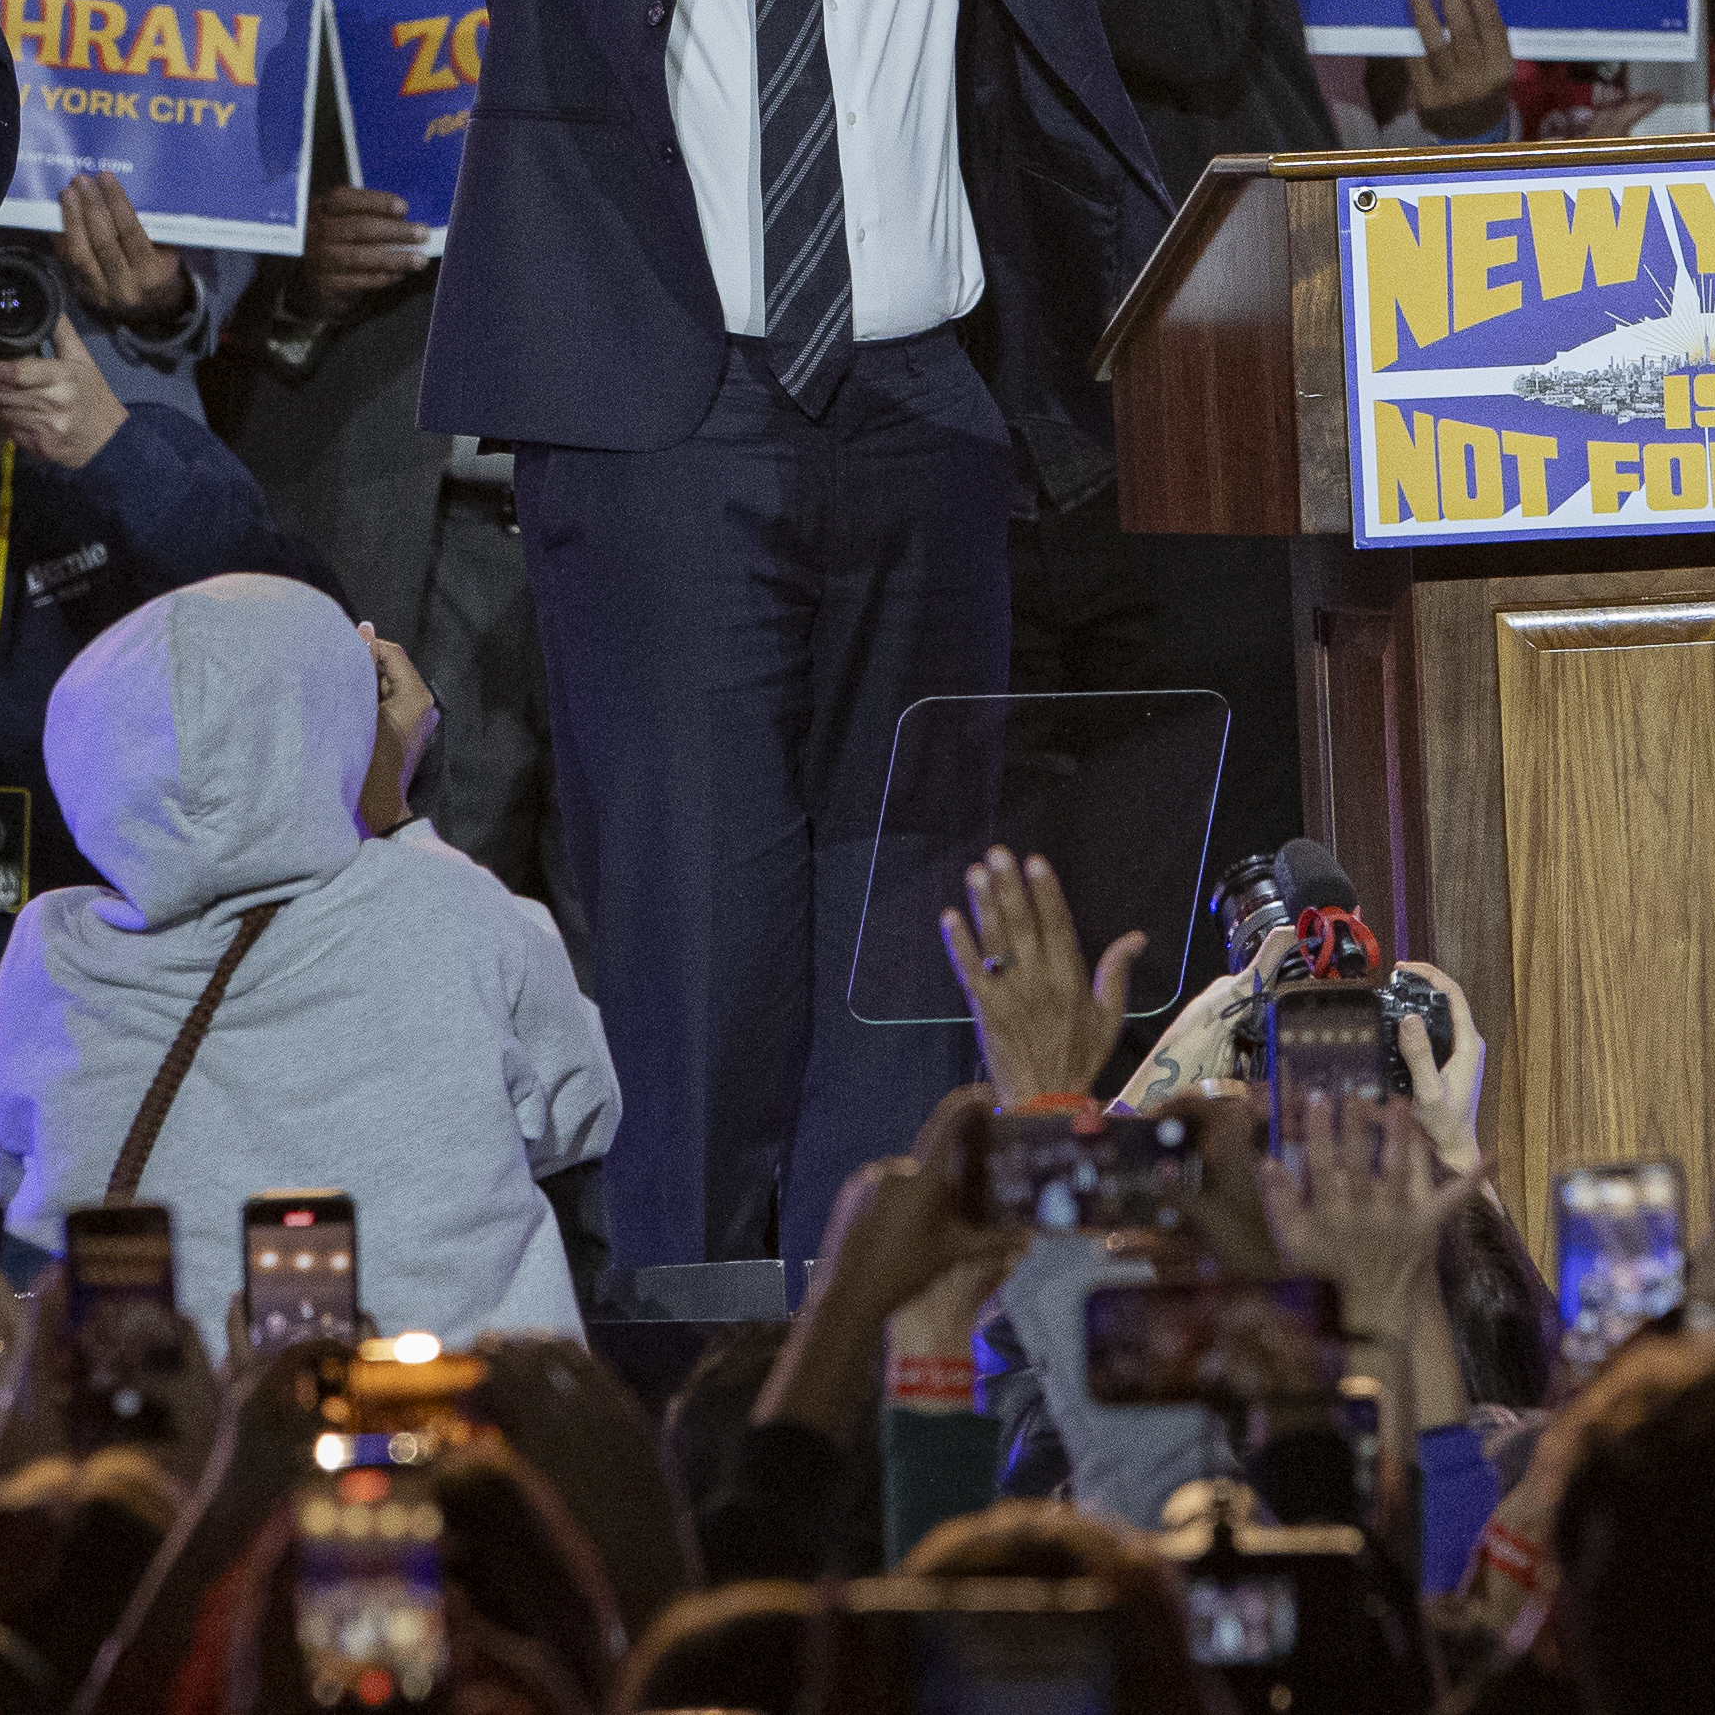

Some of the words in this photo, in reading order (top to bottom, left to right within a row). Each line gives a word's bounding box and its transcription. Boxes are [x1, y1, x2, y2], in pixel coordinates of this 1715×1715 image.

[40, 84, 139, 120] YORK
[148, 93, 235, 130] CITY
[1365, 185, 1652, 374] NEW
[1372, 398, 1559, 525] NOT
